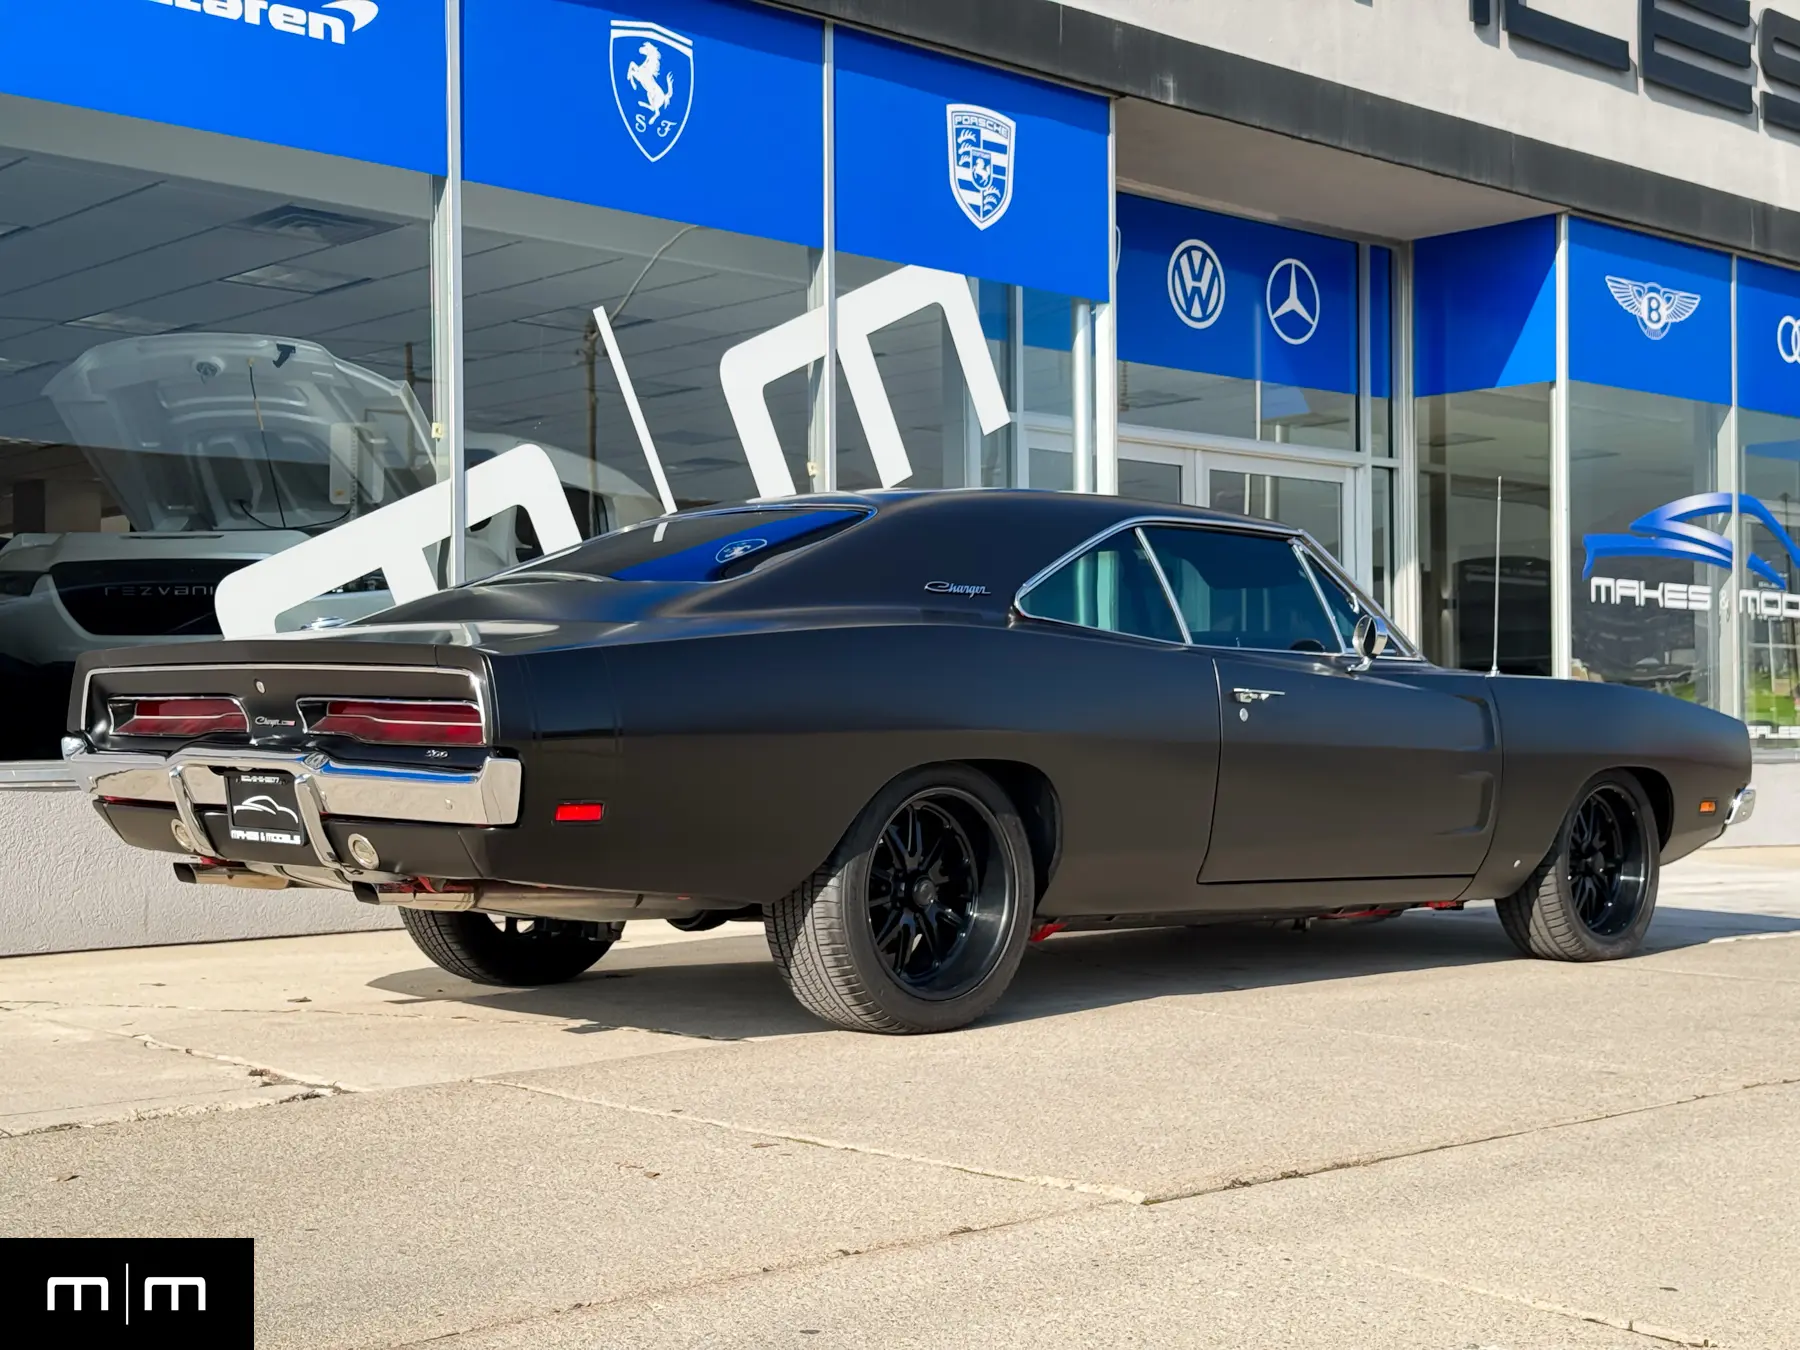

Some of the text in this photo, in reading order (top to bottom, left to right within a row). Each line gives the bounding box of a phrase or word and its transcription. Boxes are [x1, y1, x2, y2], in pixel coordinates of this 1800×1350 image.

[954, 114, 1009, 139] PORSCHE
[923, 580, 992, 600] Charger
[1590, 576, 1713, 612] MAKES
